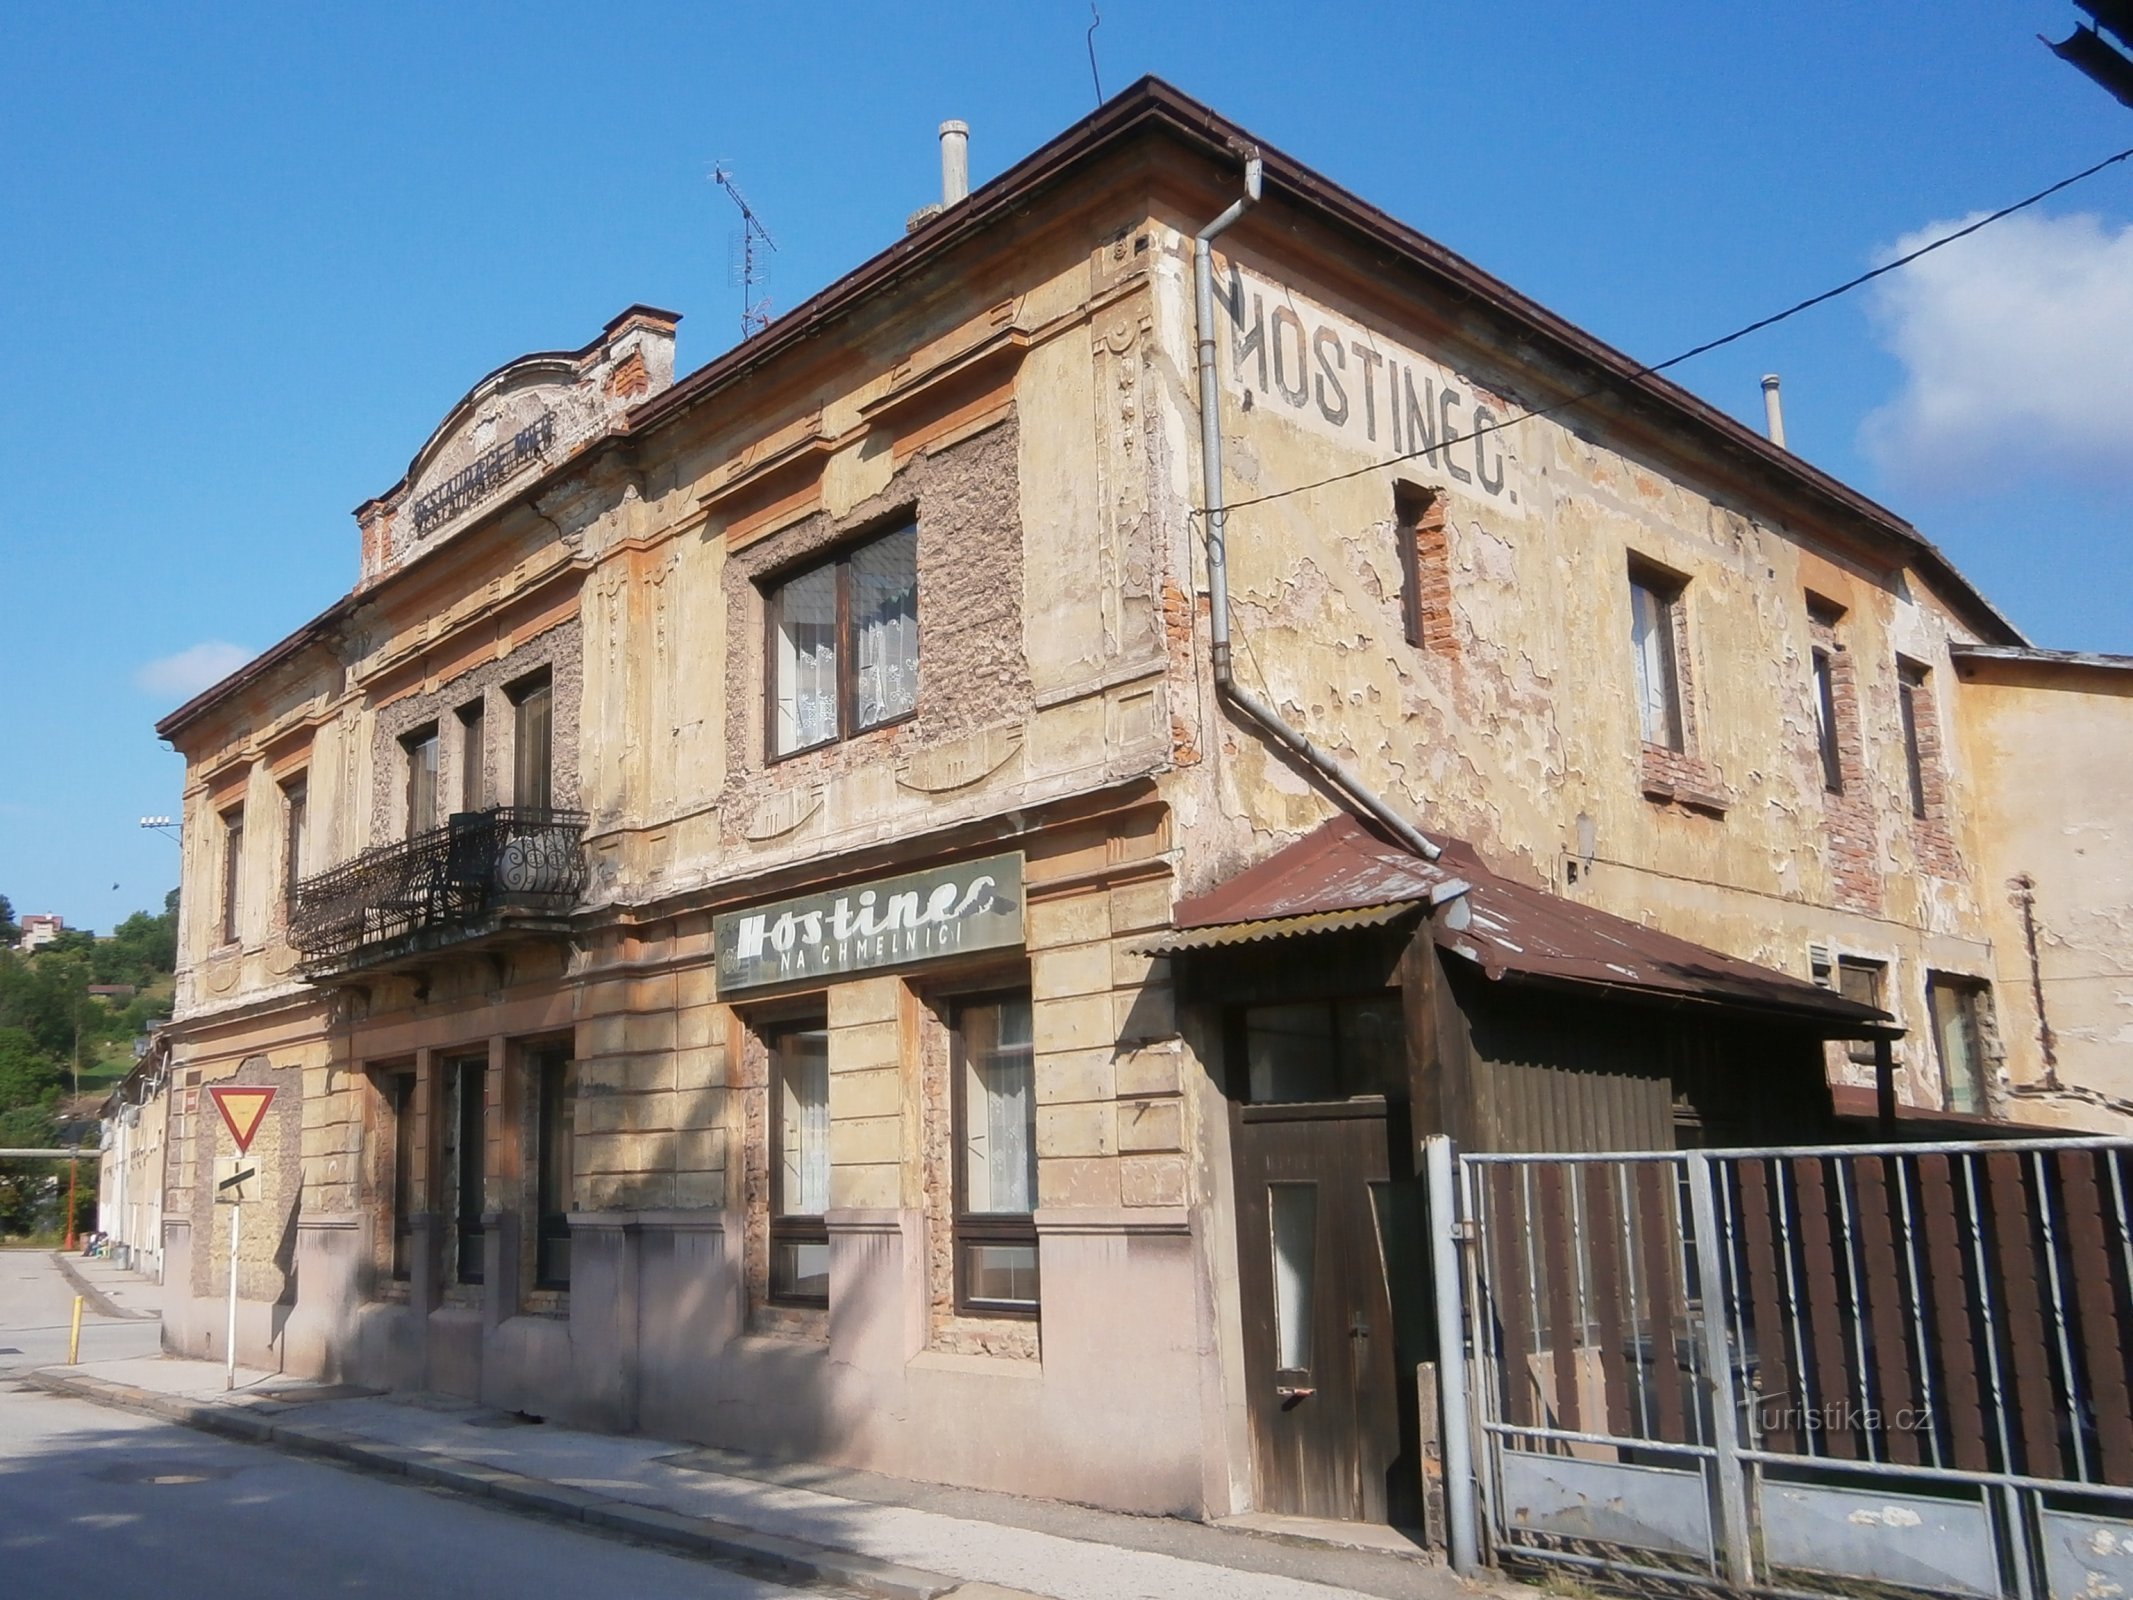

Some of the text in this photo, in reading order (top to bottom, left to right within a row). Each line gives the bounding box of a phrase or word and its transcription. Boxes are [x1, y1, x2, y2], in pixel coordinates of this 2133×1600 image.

[736, 875, 996, 960] Hostinec
[780, 921, 961, 972] NA CHMELNICI
